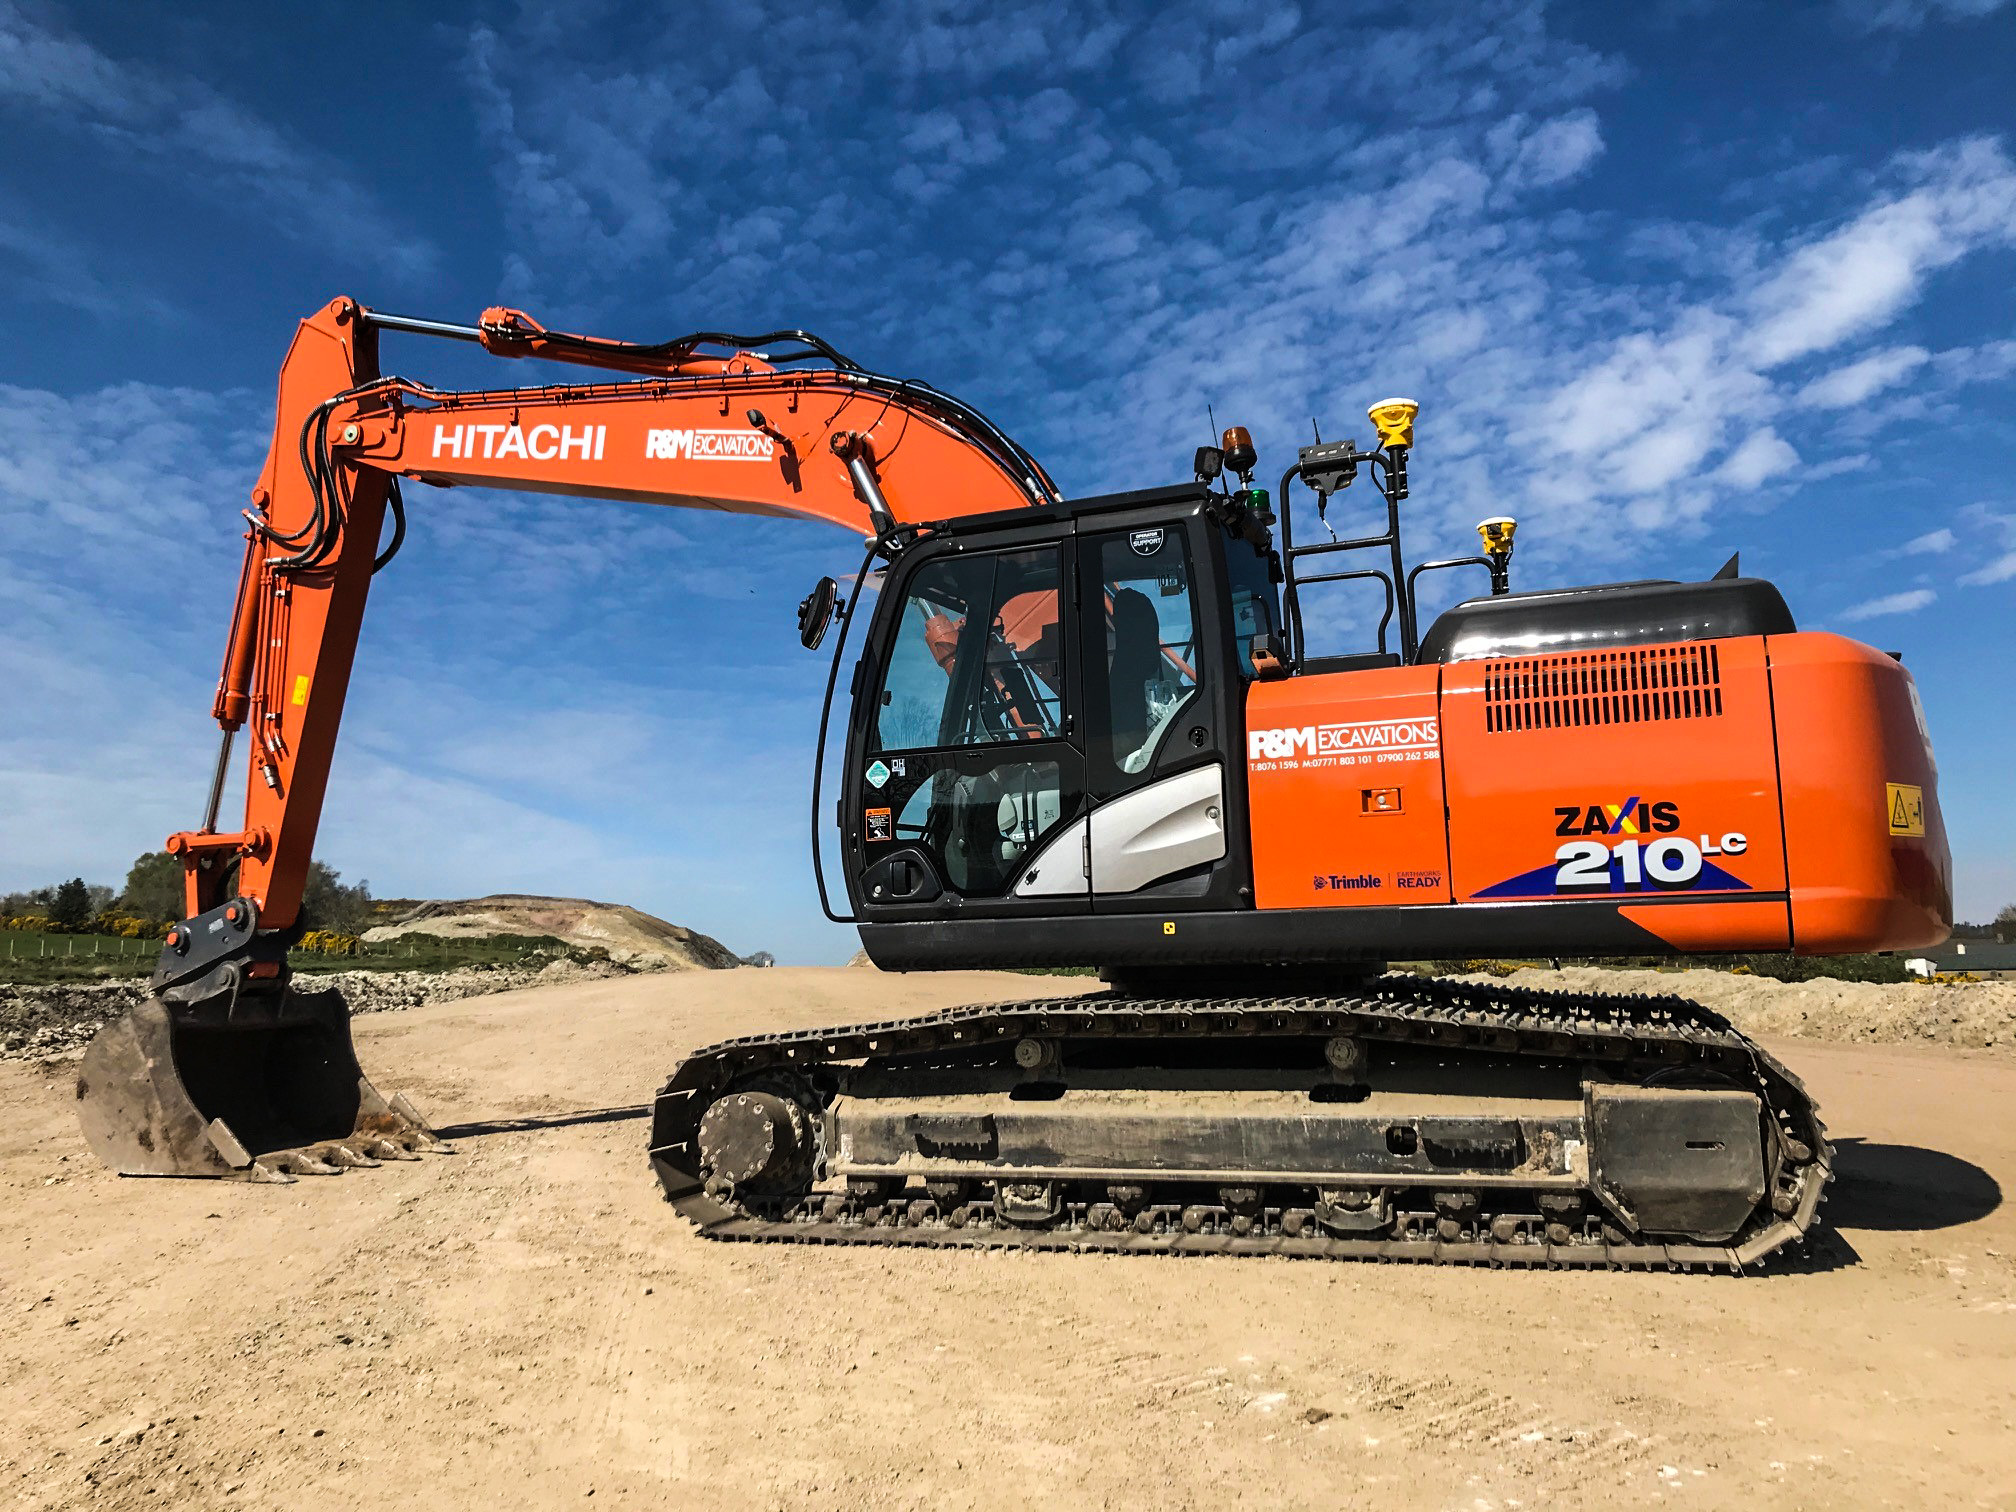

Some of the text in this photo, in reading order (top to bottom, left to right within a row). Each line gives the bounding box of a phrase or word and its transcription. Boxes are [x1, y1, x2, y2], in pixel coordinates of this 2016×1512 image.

[432, 425, 606, 460] HITACHI
[693, 434, 774, 457] EXCAVATIONS
[1133, 537, 1161, 547] SUPPORT
[1318, 722, 1439, 750] EXCAVATIONS
[1250, 750, 1440, 772] T:8076 1596 M:07771 803 101 07900 262 588
[1555, 797, 1680, 836] ZAXIS
[1328, 874, 1381, 890] Trimble
[1398, 877, 1441, 888] READY
